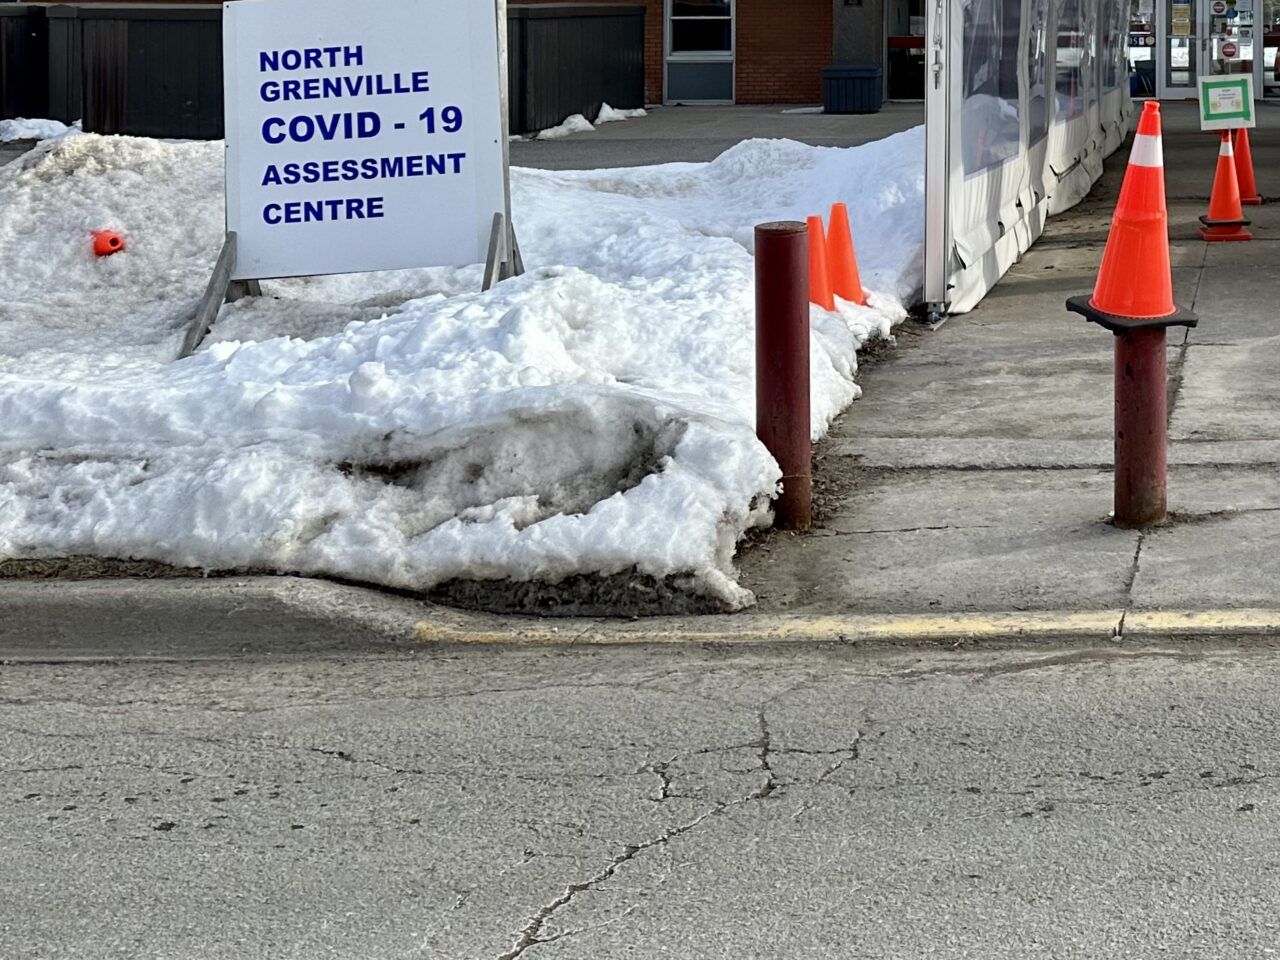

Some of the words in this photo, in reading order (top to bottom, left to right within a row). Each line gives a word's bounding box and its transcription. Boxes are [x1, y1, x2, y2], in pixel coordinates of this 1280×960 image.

[259, 45, 363, 72] NORTH
[259, 71, 429, 102] GRENVILLE
[261, 111, 381, 145] COVID
[418, 105, 463, 134] 19
[261, 152, 467, 186] ASSESSMENT
[262, 196, 385, 225] CENTRE
